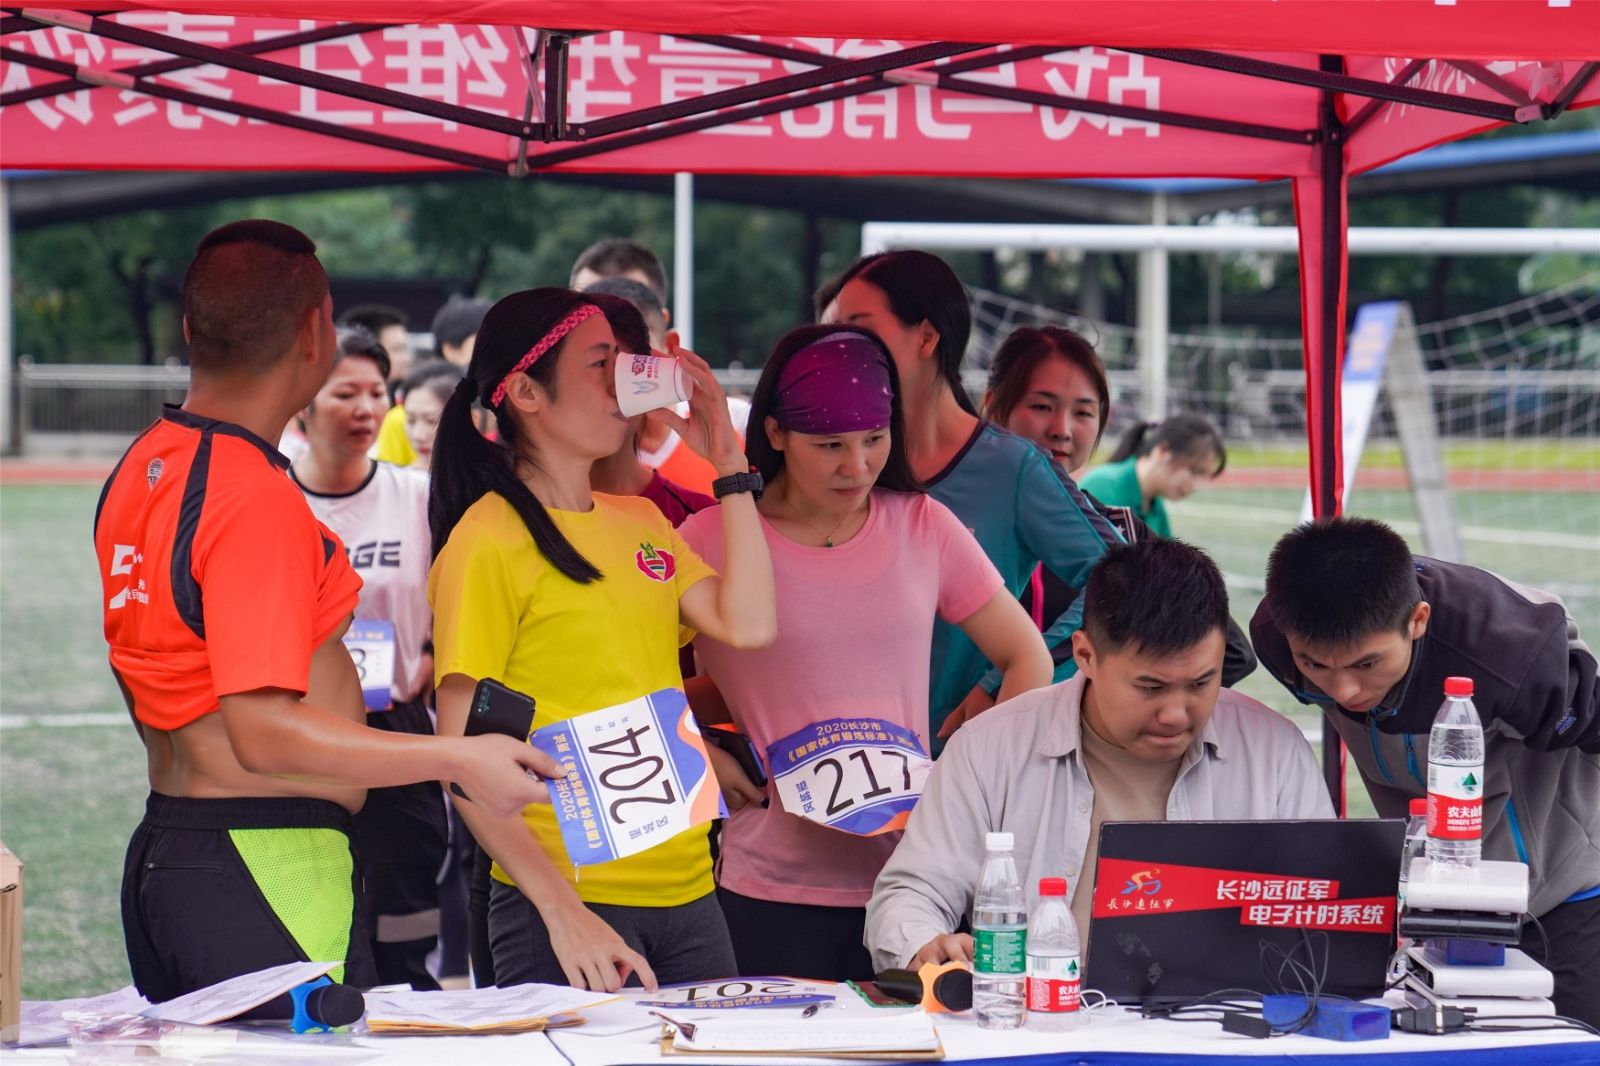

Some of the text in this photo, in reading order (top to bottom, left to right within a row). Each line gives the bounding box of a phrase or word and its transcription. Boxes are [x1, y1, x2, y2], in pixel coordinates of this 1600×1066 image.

[345, 541, 401, 568] GE
[816, 721, 882, 736] 2020长沙市
[588, 725, 677, 825] 204
[813, 749, 912, 816] 217
[796, 780, 816, 813] 望城区
[1216, 880, 1332, 900] 长沙远征军
[1249, 904, 1385, 926] 电子计时系统
[678, 982, 796, 1002] 201
